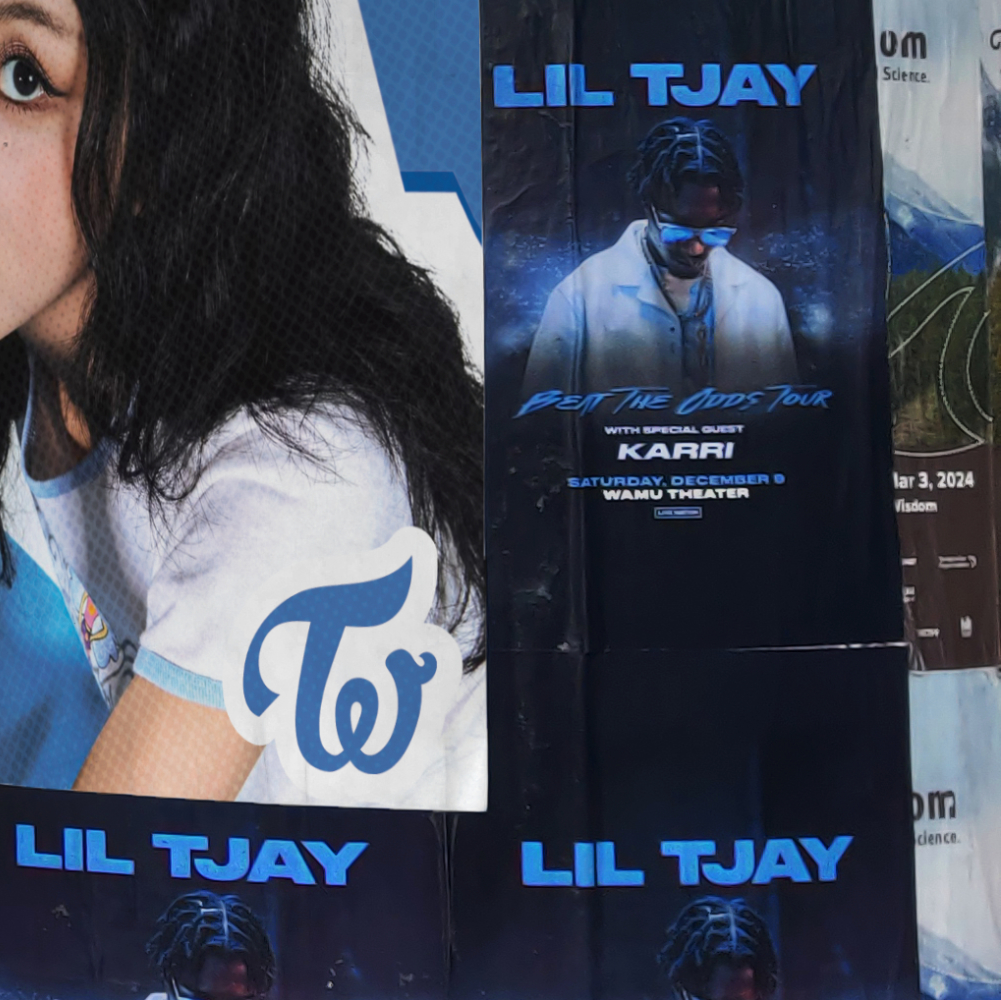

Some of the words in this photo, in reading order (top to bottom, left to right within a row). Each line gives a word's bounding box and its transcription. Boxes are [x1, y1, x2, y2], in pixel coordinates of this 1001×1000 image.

[492, 64, 615, 108] LIL
[630, 63, 818, 107] TJAY
[604, 426, 641, 435] WITH
[642, 425, 699, 435] SPECIAL
[701, 425, 745, 434] GUEST
[617, 442, 735, 460] KARRI
[567, 475, 667, 488] SATURDAY,
[670, 474, 770, 487] DECEMBER
[918, 471, 934, 492] 3,
[937, 471, 975, 489] 2024
[603, 489, 663, 500] WAMU
[667, 488, 750, 500] THEATER
[916, 830, 962, 846] cience.
[15, 823, 135, 875] LIL
[151, 832, 370, 886] TJAY
[521, 839, 645, 888] LIL
[660, 835, 855, 887] TJAY
